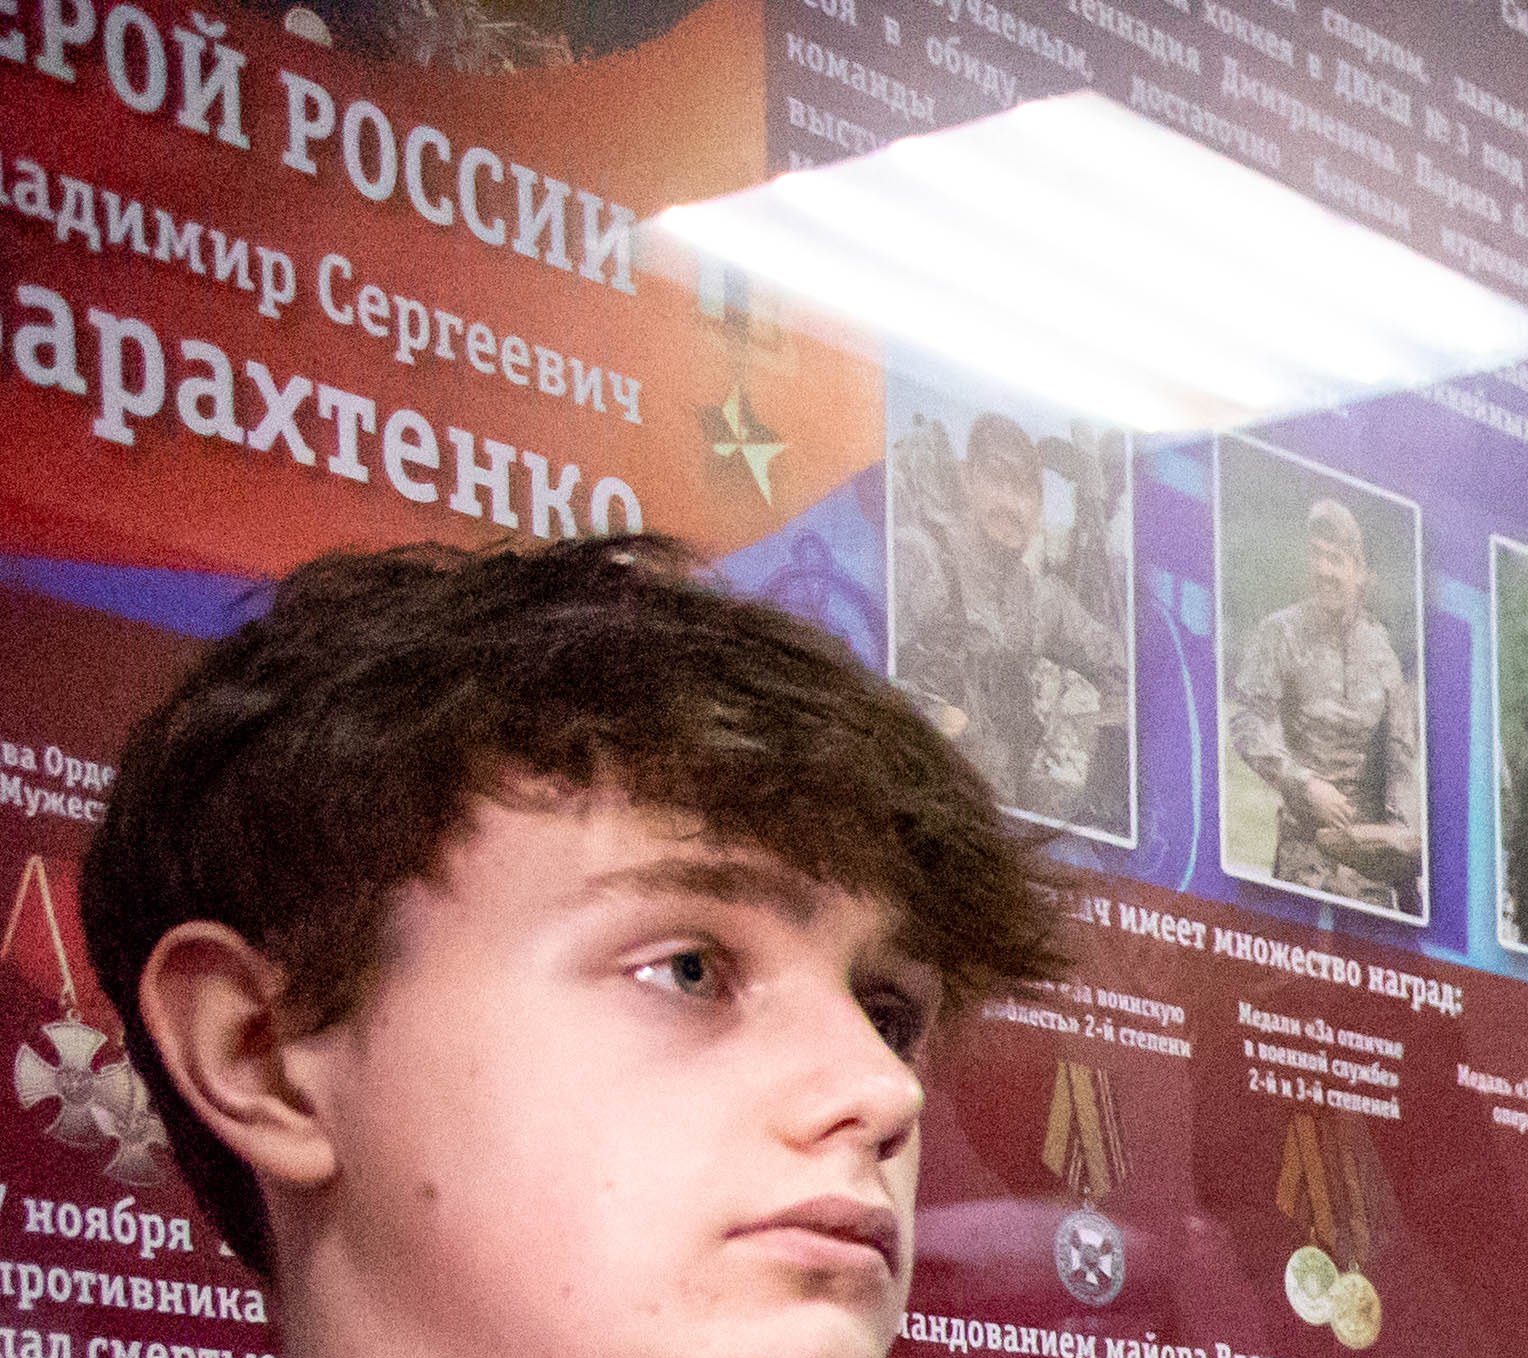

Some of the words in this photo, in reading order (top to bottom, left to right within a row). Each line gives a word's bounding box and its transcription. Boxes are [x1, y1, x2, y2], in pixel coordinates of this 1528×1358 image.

[787, 33, 936, 125] команды
[1131, 74, 1282, 169] достаточно
[1203, 6, 1296, 66] хоккея
[1309, 52, 1322, 80] в
[1334, 57, 1413, 128] ДЮСШ
[1483, 141, 1525, 191] под
[0, 0, 250, 151] РОЙ
[279, 70, 638, 297] РОССИИ
[1416, 152, 1502, 225] Парень
[0, 155, 297, 320] адимир
[318, 253, 643, 425] Сергеевич
[1119, 901, 1207, 951] имеет
[1214, 927, 1363, 988] множество
[1367, 964, 1465, 1018] наград:
[24, 1195, 194, 1261] ноября
